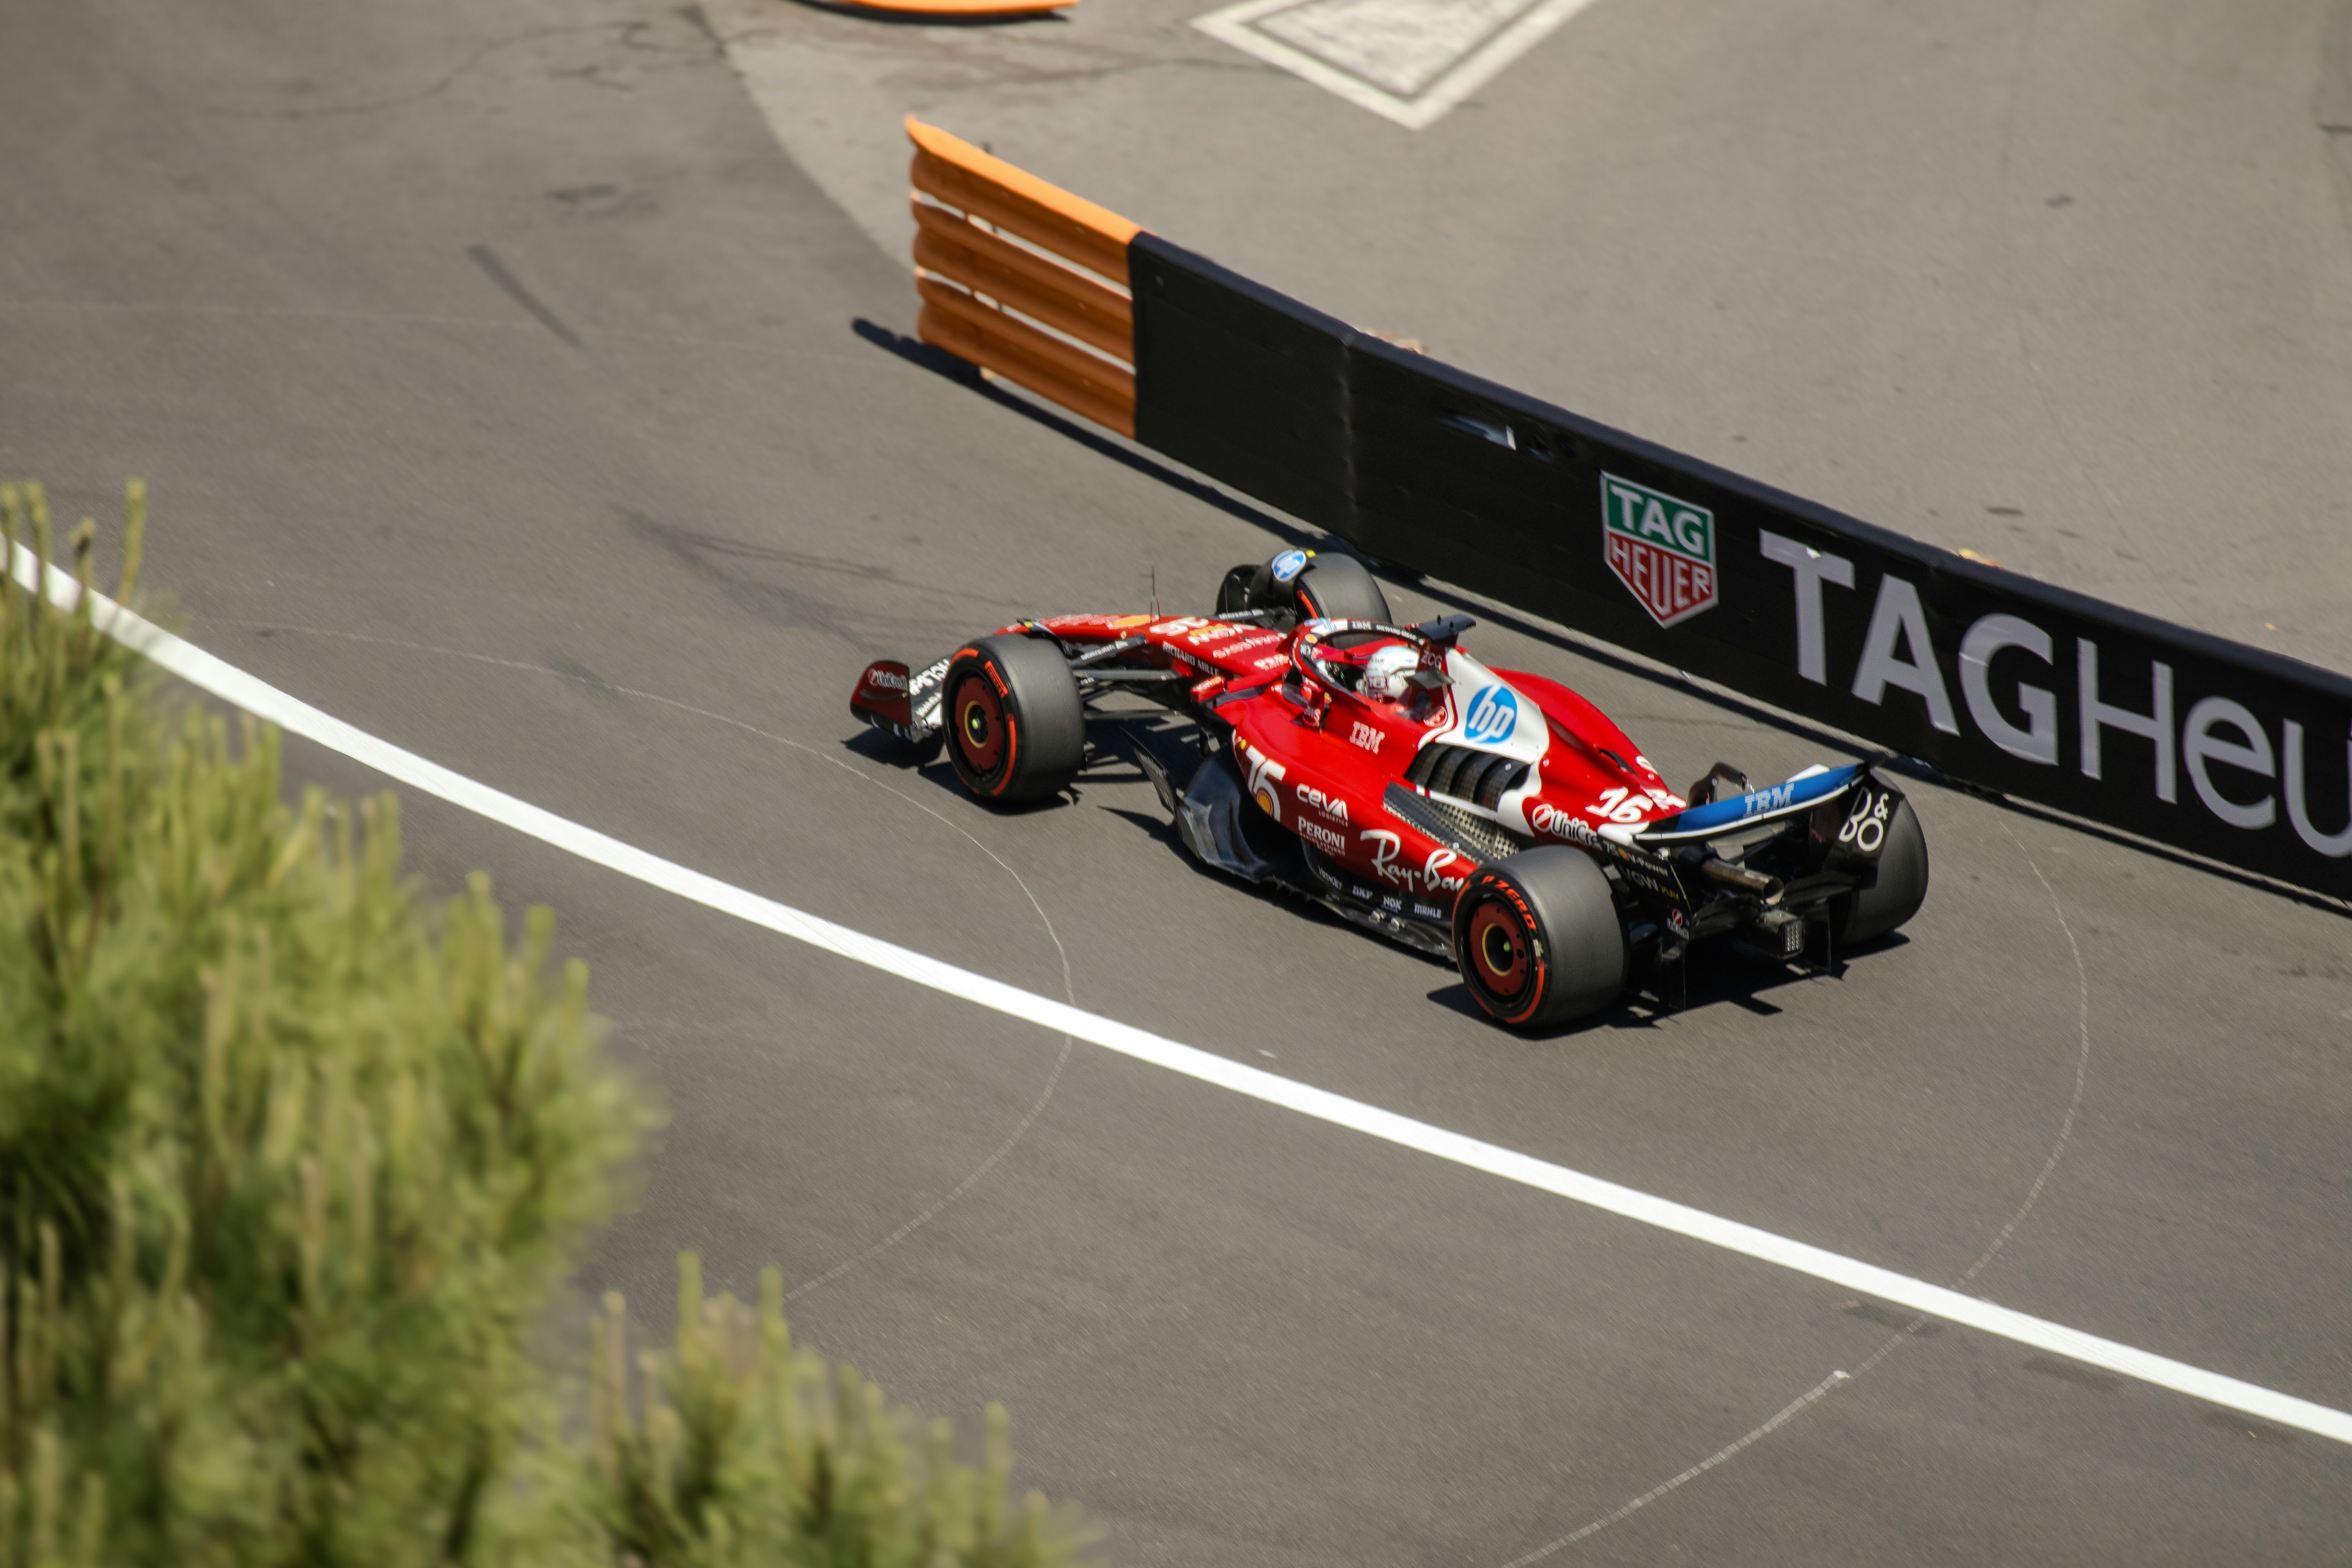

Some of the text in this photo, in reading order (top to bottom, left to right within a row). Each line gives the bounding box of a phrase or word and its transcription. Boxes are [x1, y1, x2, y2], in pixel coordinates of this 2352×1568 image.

[1610, 484, 1704, 555] TAG
[1610, 537, 1711, 616] HEUER
[1162, 641, 1196, 666] RICHARD
[1467, 685, 1515, 742] hp
[1349, 721, 1385, 754] IBM
[1584, 787, 1654, 823] 16
[1743, 783, 1795, 818] IBM
[1298, 816, 1345, 850] PERONI
[1494, 880, 1537, 930] ZERO
